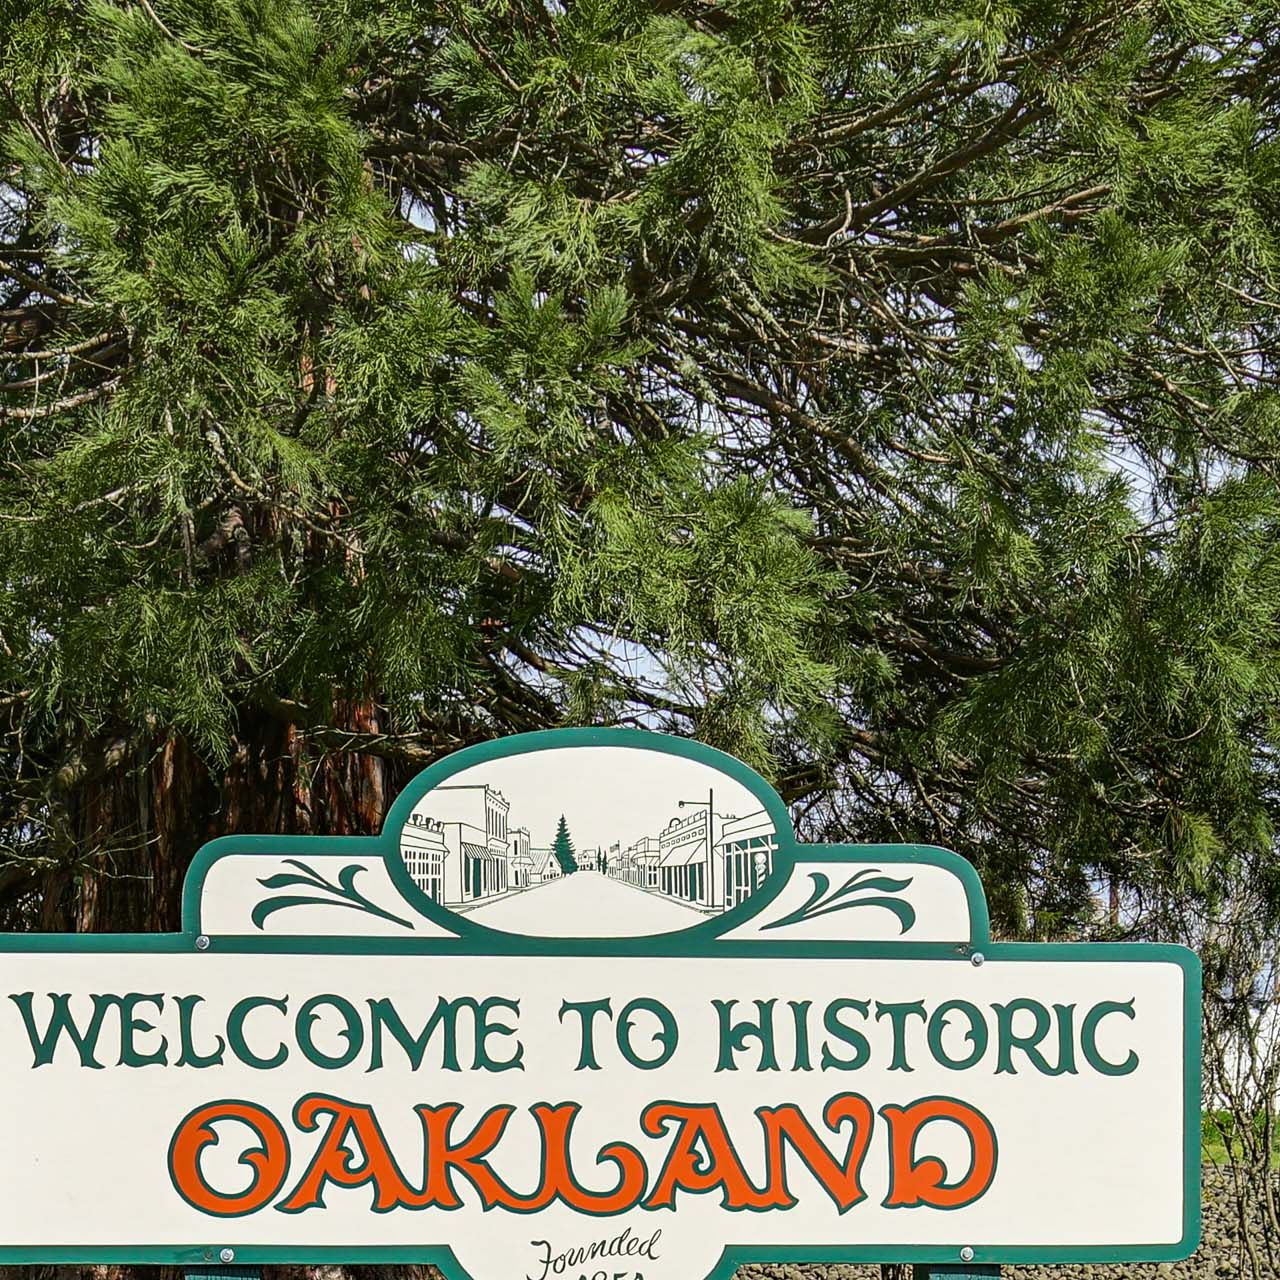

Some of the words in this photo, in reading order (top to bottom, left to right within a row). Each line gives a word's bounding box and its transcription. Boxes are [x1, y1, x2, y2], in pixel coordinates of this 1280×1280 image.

[7, 991, 526, 1074] WELCOME
[558, 996, 679, 1072] TO
[710, 996, 1140, 1077] HISTORIC
[166, 1091, 999, 1219] OAKLAND
